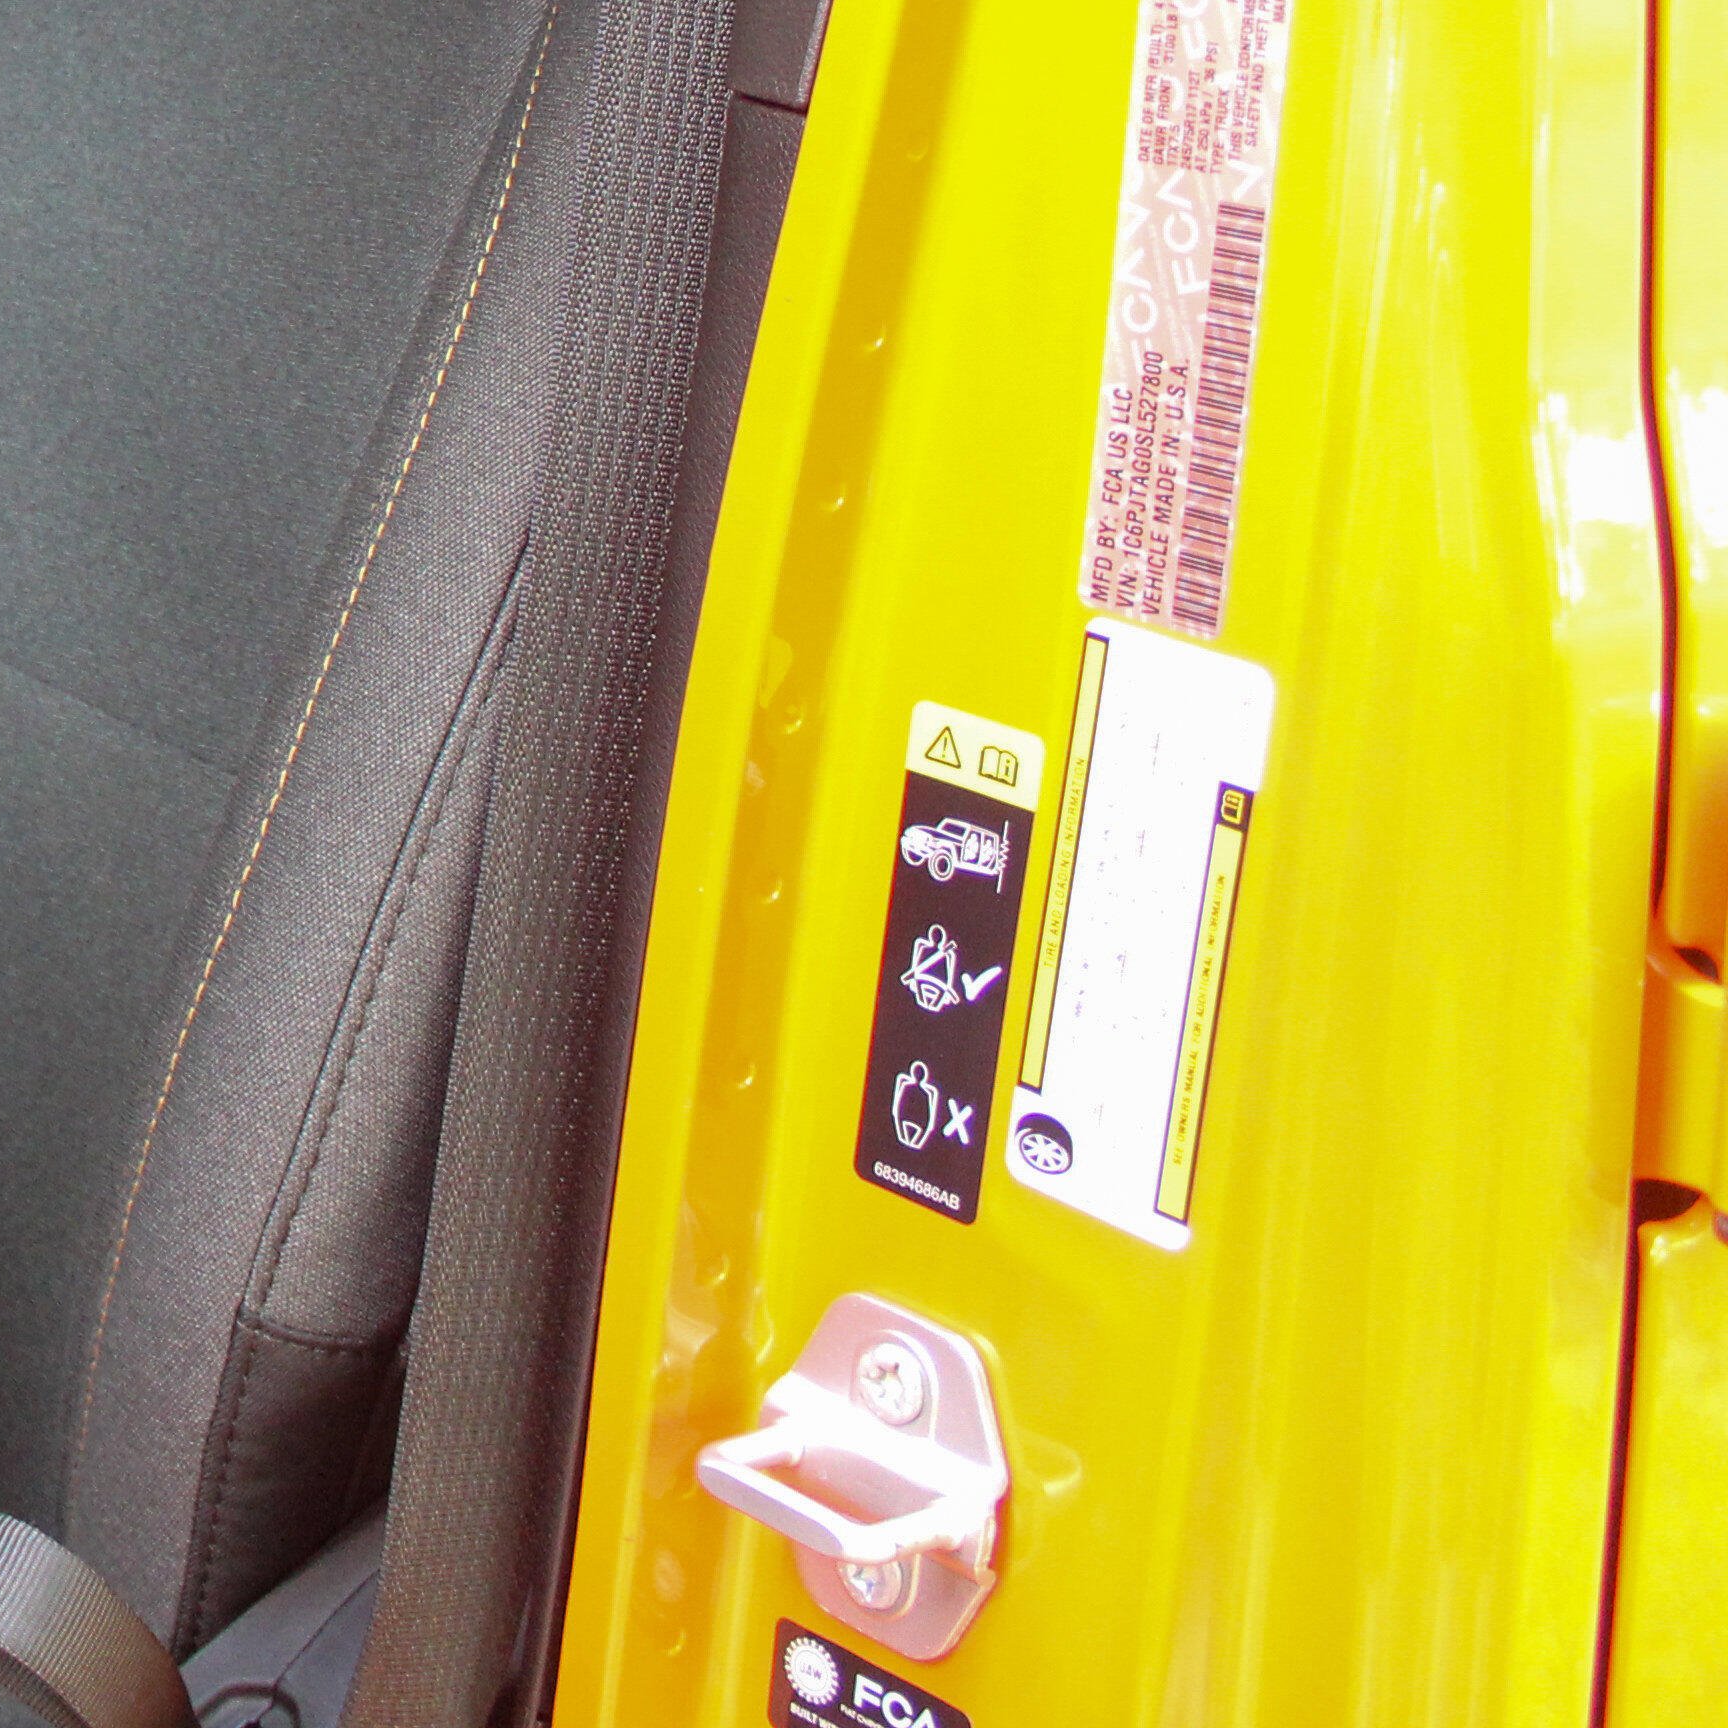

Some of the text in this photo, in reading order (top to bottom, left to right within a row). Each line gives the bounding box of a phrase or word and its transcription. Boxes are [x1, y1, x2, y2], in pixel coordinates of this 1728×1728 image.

[1167, 14, 1178, 29] LB
[1255, 18, 1268, 58] THEFT
[1163, 33, 1176, 64] 3100
[1145, 74, 1157, 104] MFR
[1251, 63, 1264, 92] AND
[1143, 107, 1154, 124] OF
[1215, 88, 1229, 132] TRUCK
[1233, 74, 1248, 127] VEHICLE
[1246, 96, 1260, 147] SAFETY
[1139, 127, 1152, 162] DATE
[1153, 125, 1167, 165] GAWR
[1195, 156, 1206, 173] AT
[1211, 142, 1224, 176] TYPE
[1230, 132, 1242, 160] THIS
[1160, 427, 1181, 458] IN:
[1091, 387, 1132, 602] MFD BY: FCA US LLC
[1153, 462, 1177, 524] MADE
[1116, 567, 1138, 609] VIN:
[1142, 531, 1169, 616] VEHICLE
[1044, 757, 1086, 968] TIRE AND LOADING INFORMATION
[1183, 1050, 1198, 1092] MANUAL
[1194, 955, 1213, 1018] ADDITIONAL
[1205, 873, 1226, 948] INFORMATION
[874, 1161, 960, 1210] 68394686AB
[854, 1674, 938, 1728] FCA
